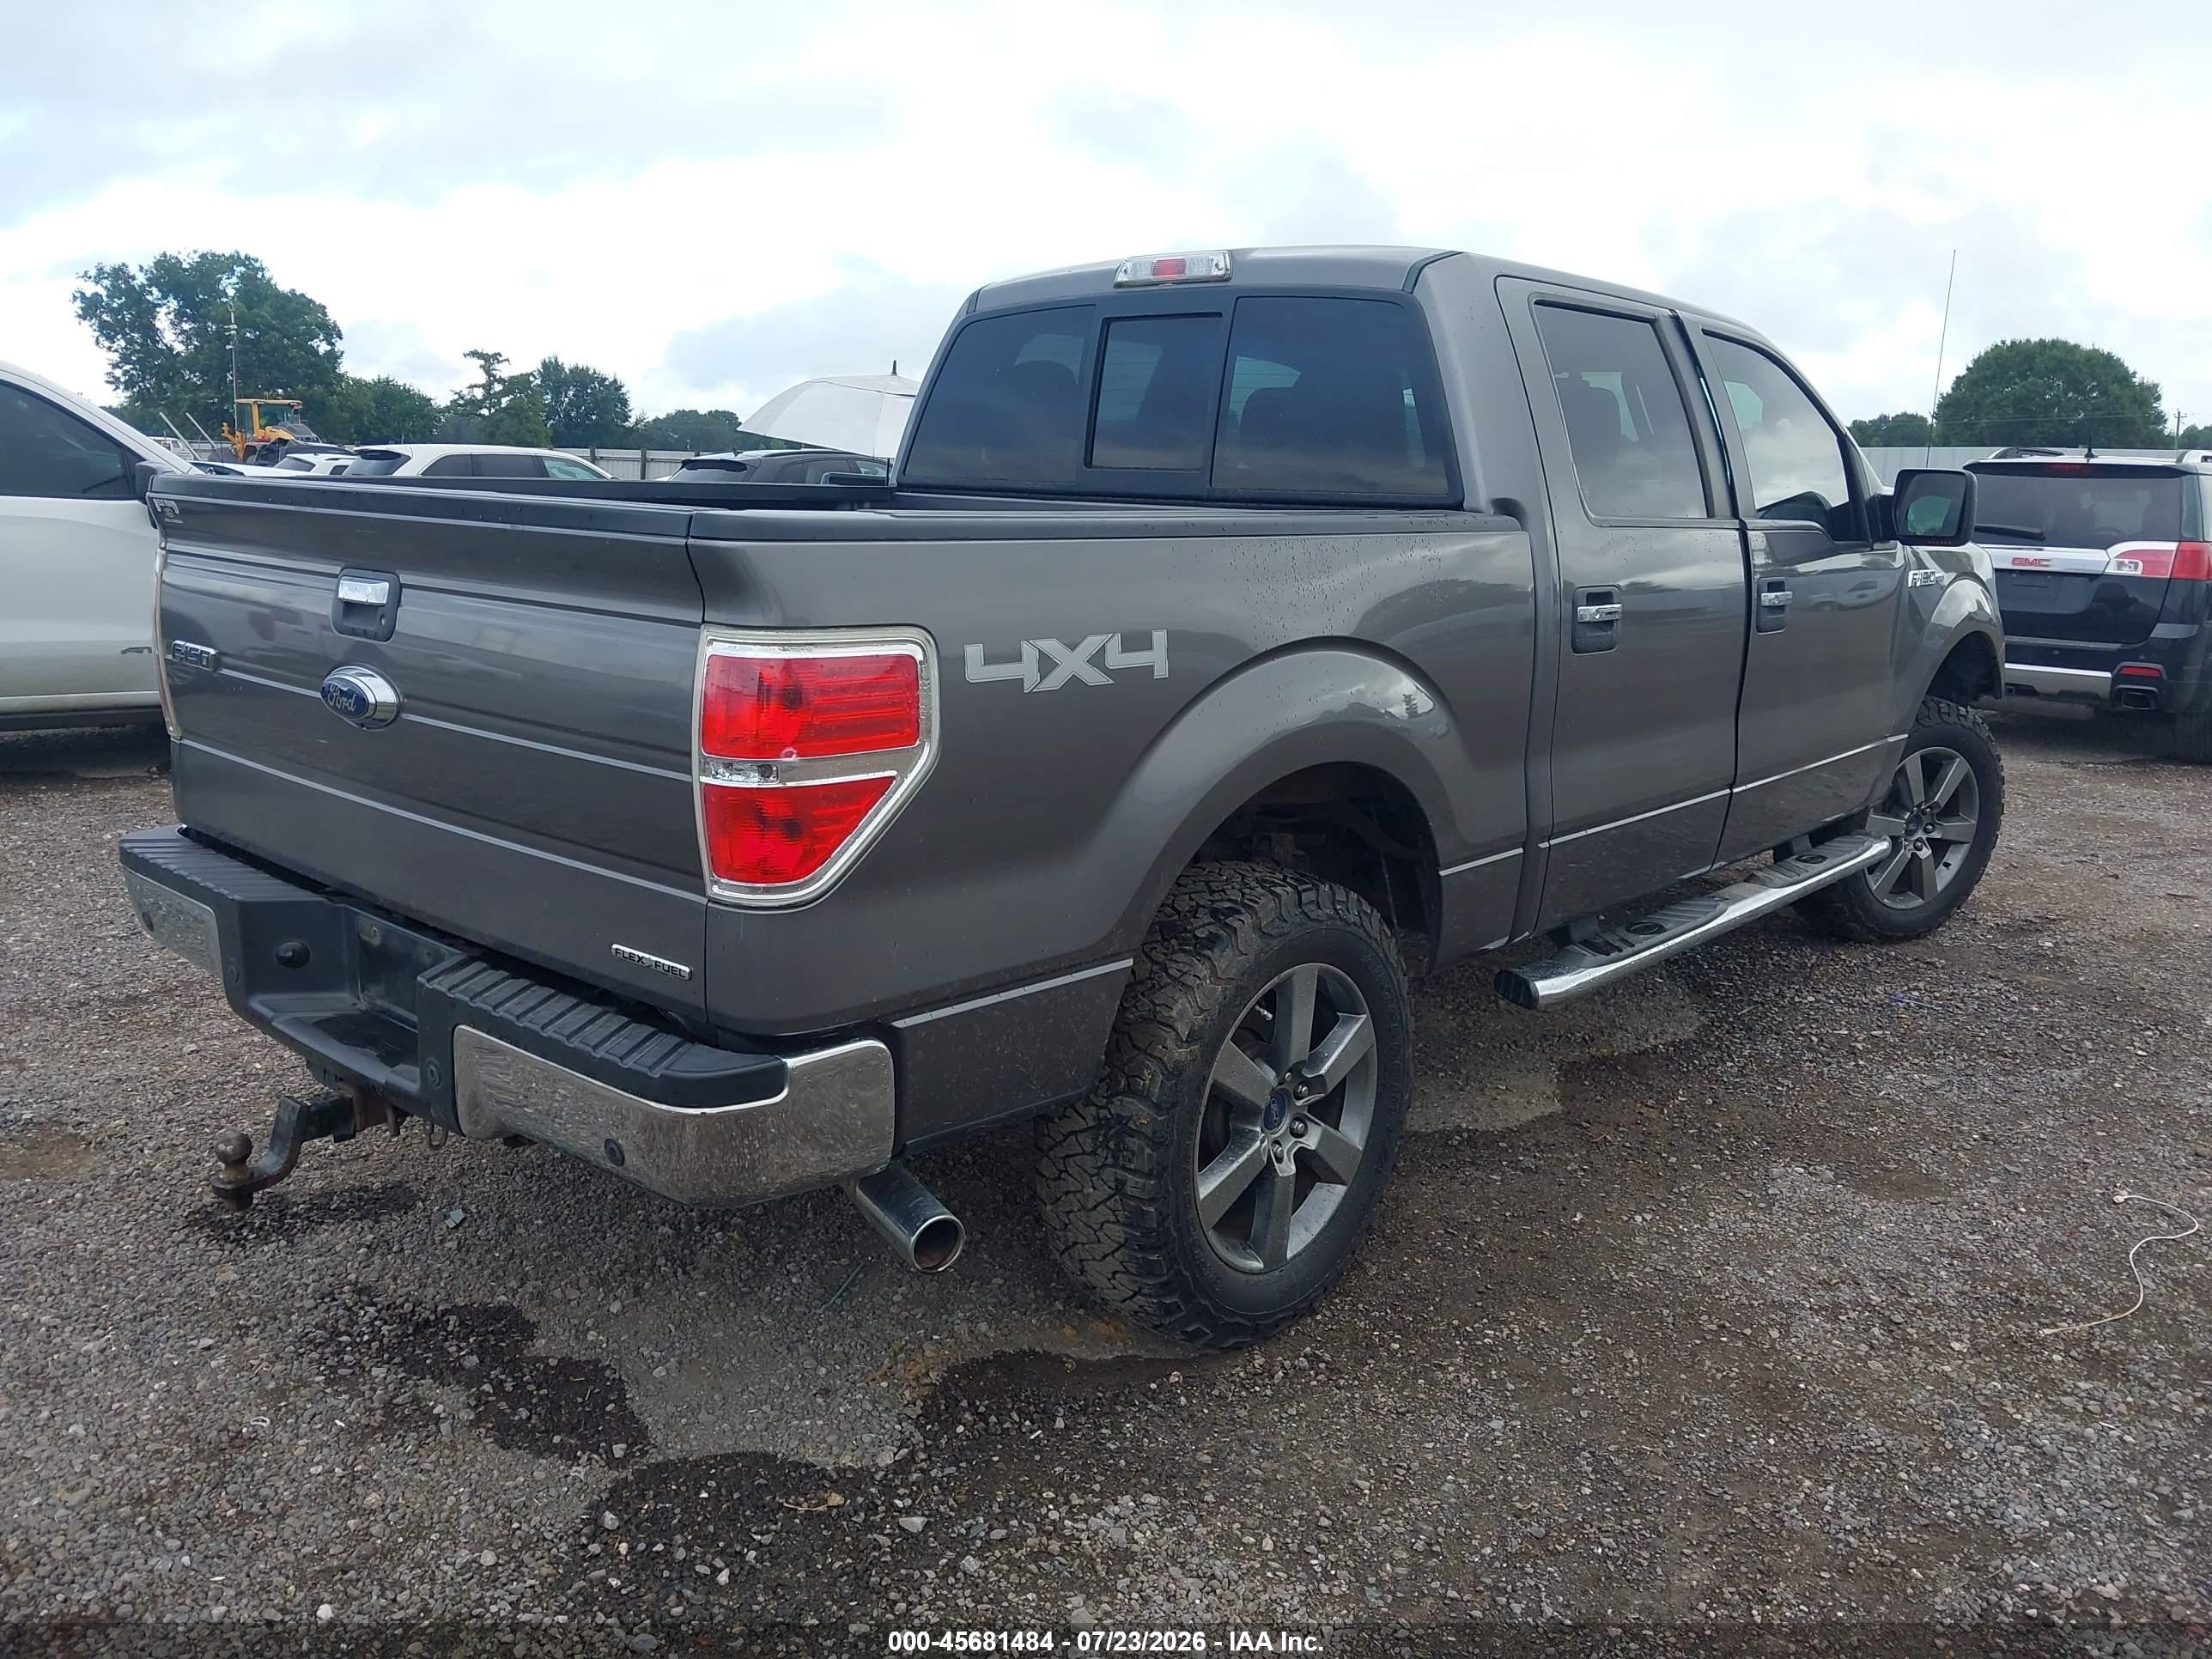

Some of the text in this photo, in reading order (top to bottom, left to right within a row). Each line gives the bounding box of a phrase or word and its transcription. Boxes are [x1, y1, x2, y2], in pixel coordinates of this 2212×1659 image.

[2011, 557, 2051, 568] GMC
[327, 682, 357, 713] Ford
[615, 948, 687, 978] FLEX FUEL
